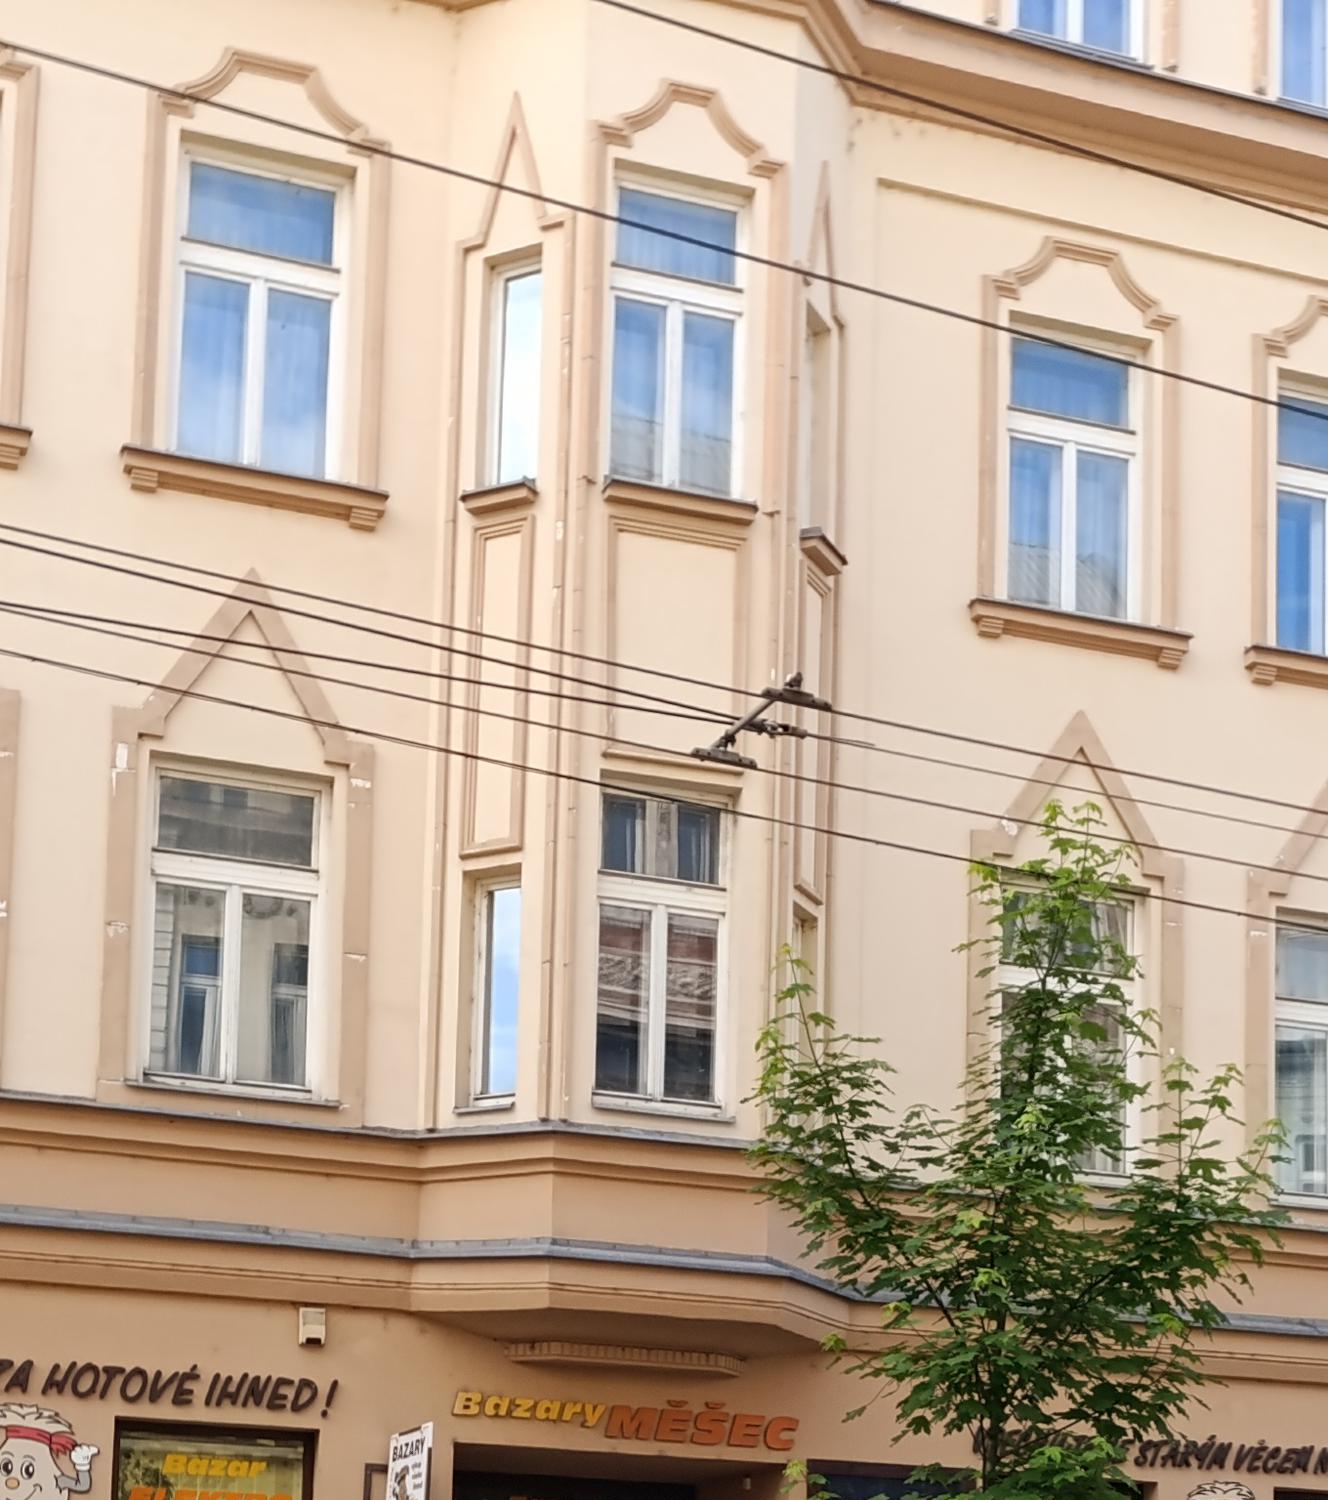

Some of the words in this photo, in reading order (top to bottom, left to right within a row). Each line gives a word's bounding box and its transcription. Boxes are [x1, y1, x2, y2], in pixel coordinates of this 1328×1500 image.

[41, 1361, 201, 1406] HOTOVÉ
[452, 1391, 607, 1428] Bazary
[604, 1399, 800, 1452] MĚŠEC
[163, 1453, 267, 1478] Bazar
[392, 1436, 426, 1463] BAZARY
[1134, 1434, 1233, 1471] STARÝM
[1231, 1439, 1315, 1475] VĚCEM
